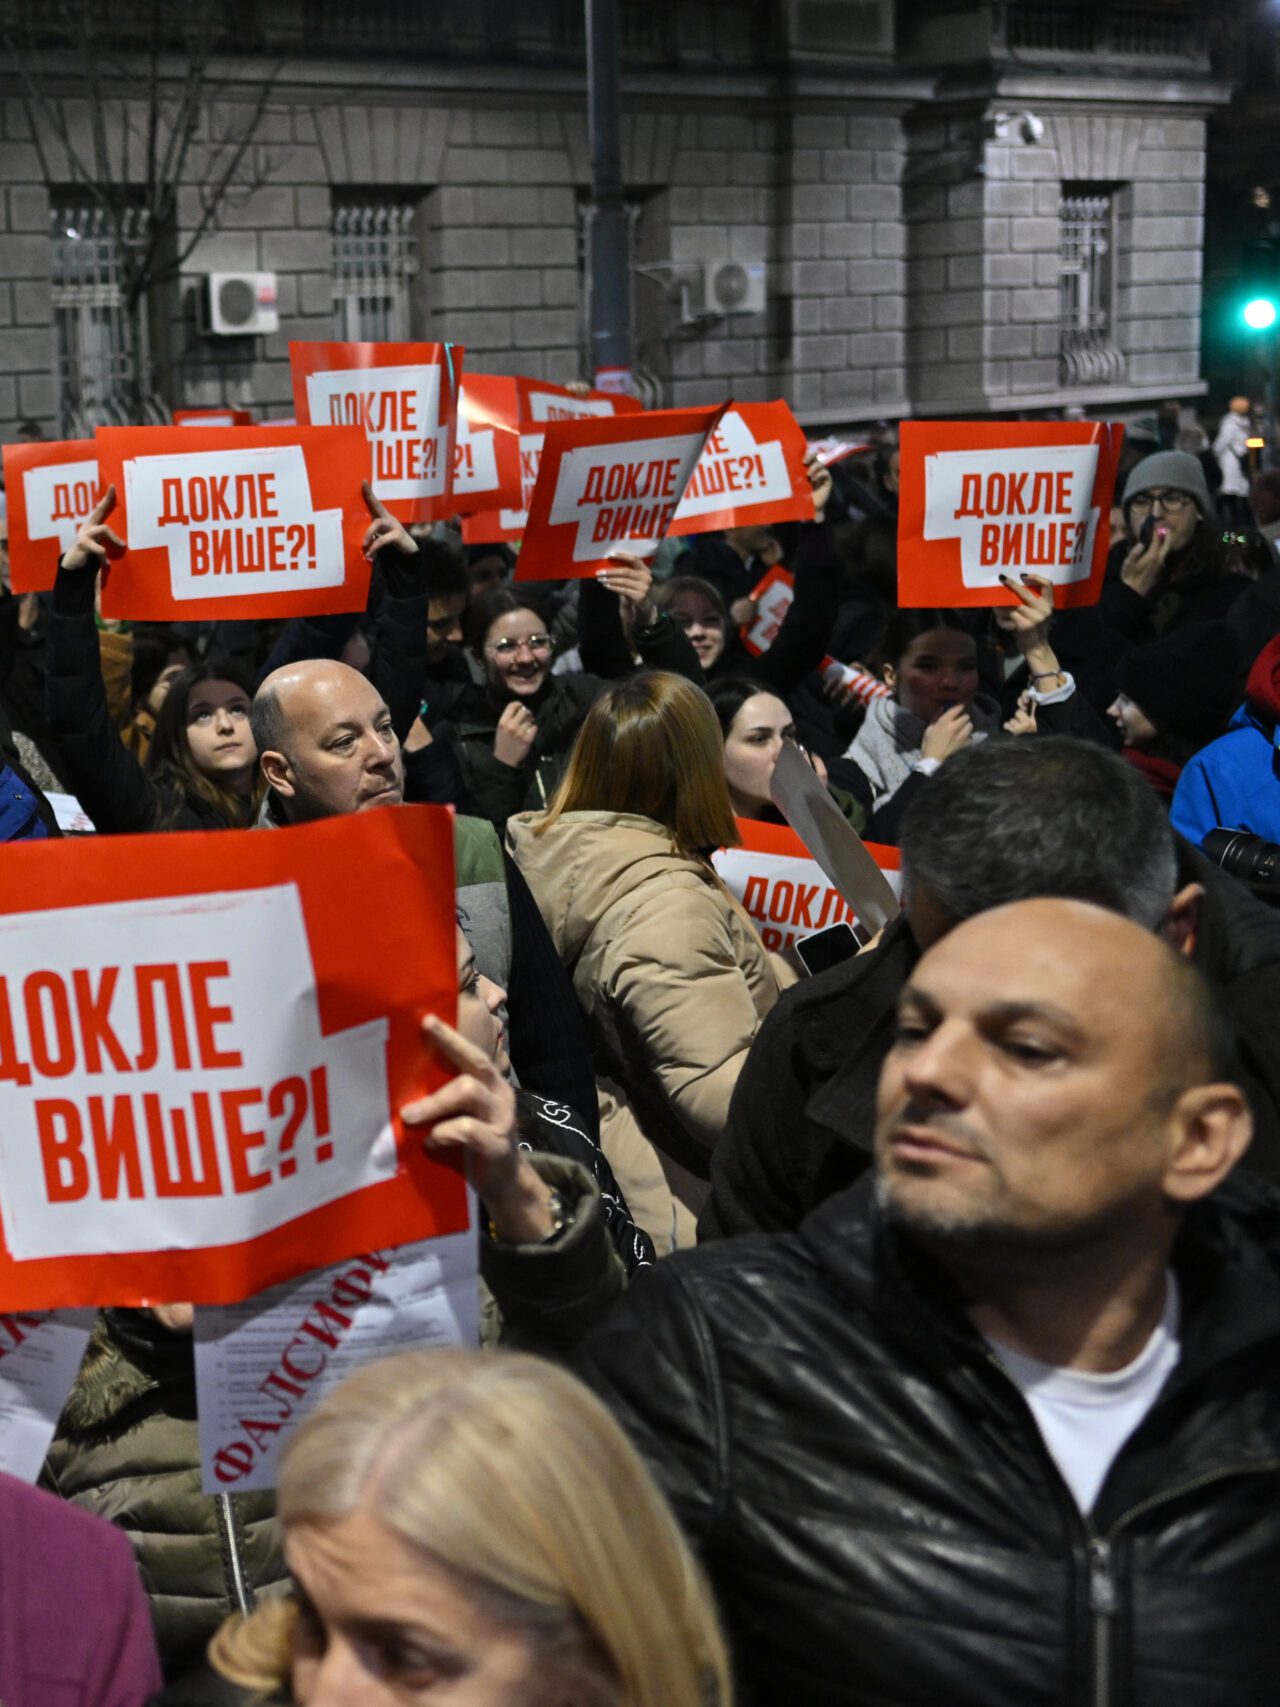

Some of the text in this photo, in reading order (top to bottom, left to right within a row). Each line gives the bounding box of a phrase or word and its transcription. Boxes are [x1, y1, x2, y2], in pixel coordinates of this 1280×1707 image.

[370, 438, 438, 480] ШЕ?!
[577, 458, 680, 507] ДОКЛЕ
[158, 473, 279, 527] ДОКЛЕ
[954, 471, 1074, 520] ДОКЛЕ
[189, 524, 317, 577] ВИШЕ?!
[980, 521, 1089, 567] ВИШЕ?!
[34, 1066, 334, 1205] ВИШЕ?!
